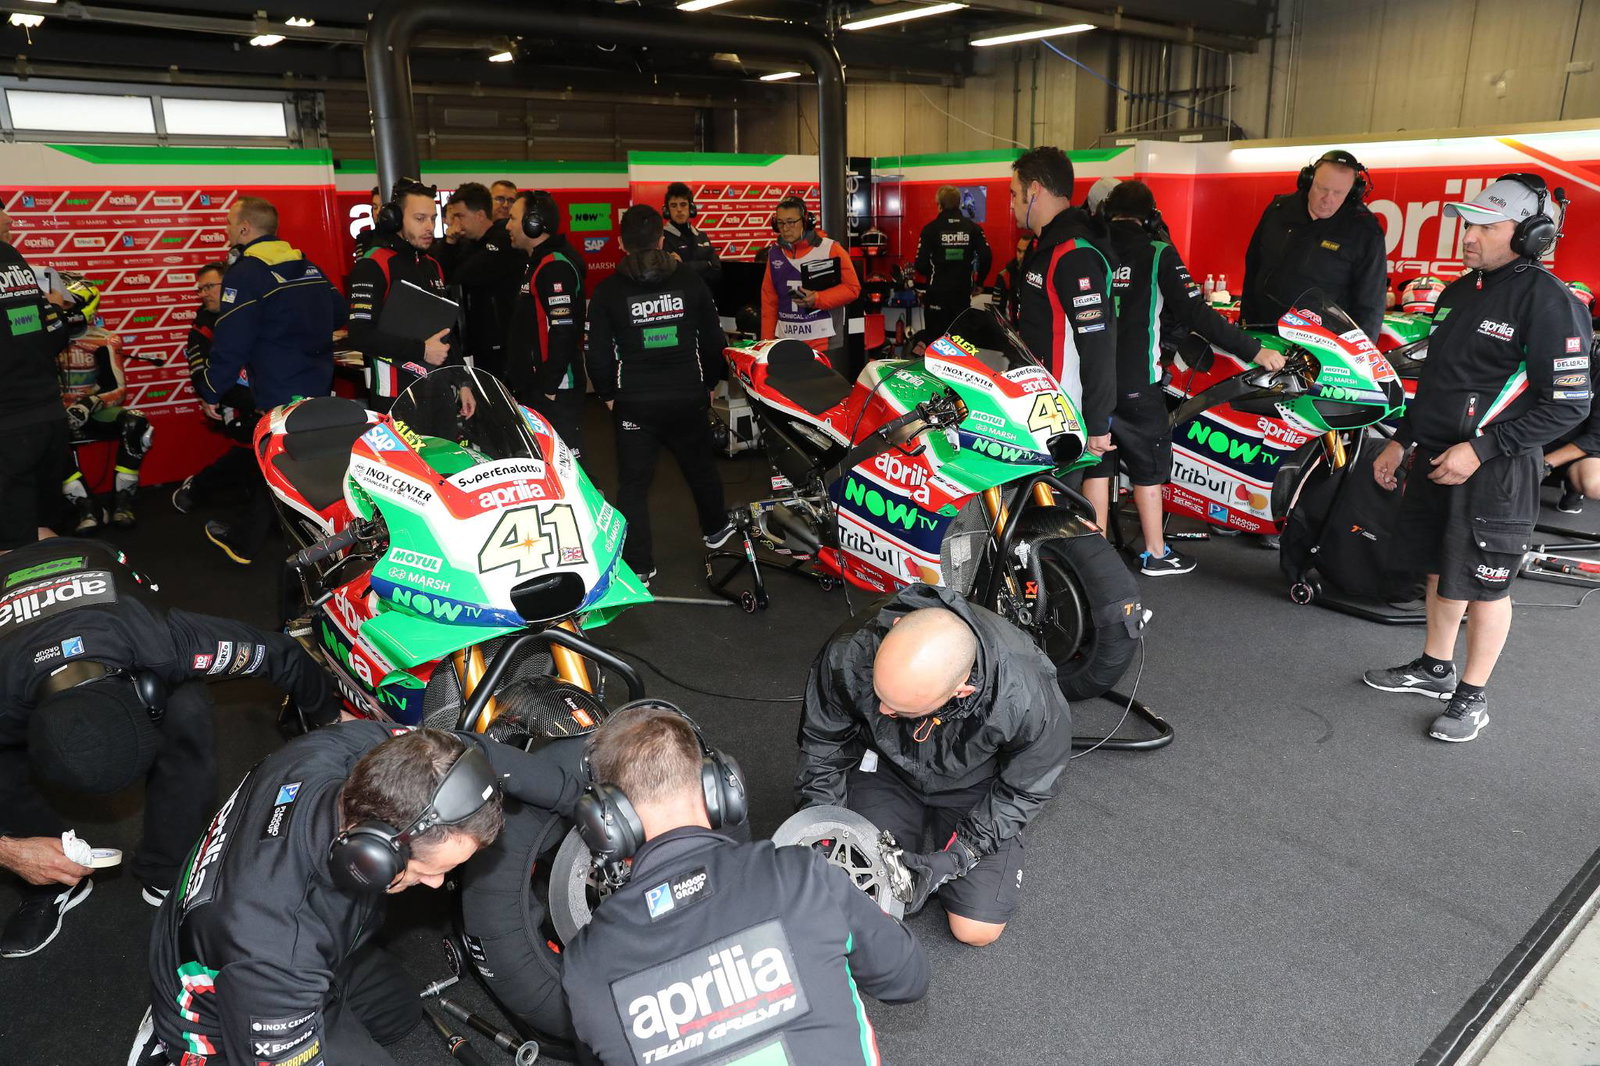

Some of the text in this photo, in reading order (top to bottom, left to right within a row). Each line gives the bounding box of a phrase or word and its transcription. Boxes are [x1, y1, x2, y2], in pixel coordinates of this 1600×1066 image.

[109, 194, 138, 205] aprilia
[575, 212, 600, 221] NOW
[24, 237, 55, 248] aprilia
[200, 232, 226, 243] aprilia
[584, 239, 605, 251] SAP
[941, 231, 970, 243] aprilia
[588, 262, 616, 270] MARSH
[0, 265, 37, 293] prilia
[123, 274, 151, 285] aprilia
[171, 310, 198, 320] aprilia
[631, 293, 684, 318] aprilia
[784, 324, 812, 335] JAPAN
[1282, 313, 1305, 327] SAP
[1479, 319, 1515, 338] aprilia
[933, 339, 958, 357] SAP
[943, 365, 964, 377] INOX
[964, 372, 994, 389] CENTER
[1324, 367, 1349, 375] MOTUL
[1333, 376, 1358, 385] MARSH
[1319, 385, 1361, 401] NOW
[972, 411, 1005, 427] MOTUL
[1026, 392, 1081, 436] 41
[366, 426, 396, 451] SAP
[988, 427, 1018, 441] MARSH
[1256, 416, 1308, 445] aprilia
[972, 437, 1035, 462] NOW TV
[1187, 420, 1280, 466] NOW TV
[366, 466, 432, 502] INOX CENTER
[458, 463, 542, 488] SuperEnalotto
[874, 452, 931, 505] aprilia
[1173, 461, 1227, 495] Tribul
[478, 479, 546, 509] aprilia
[845, 477, 918, 530] NOW
[917, 514, 938, 531] TV
[1230, 514, 1260, 529] PIAGGIO
[477, 503, 589, 577] 41
[839, 525, 894, 566] Tribul
[391, 551, 440, 571] MOTUL
[1476, 564, 1510, 578] aprilia
[407, 572, 451, 592] MARSH
[392, 586, 483, 623] NOW TV
[33, 650, 61, 664] PIAGGIO
[35, 645, 60, 658] GROUP
[271, 805, 287, 836] PIAGGIO
[673, 872, 707, 894] PIAGGIO
[675, 881, 705, 900] GROUP
[628, 944, 792, 1041] aprilia
[262, 1023, 287, 1031] INOX
[642, 995, 797, 1065] TEAM GRESINI
